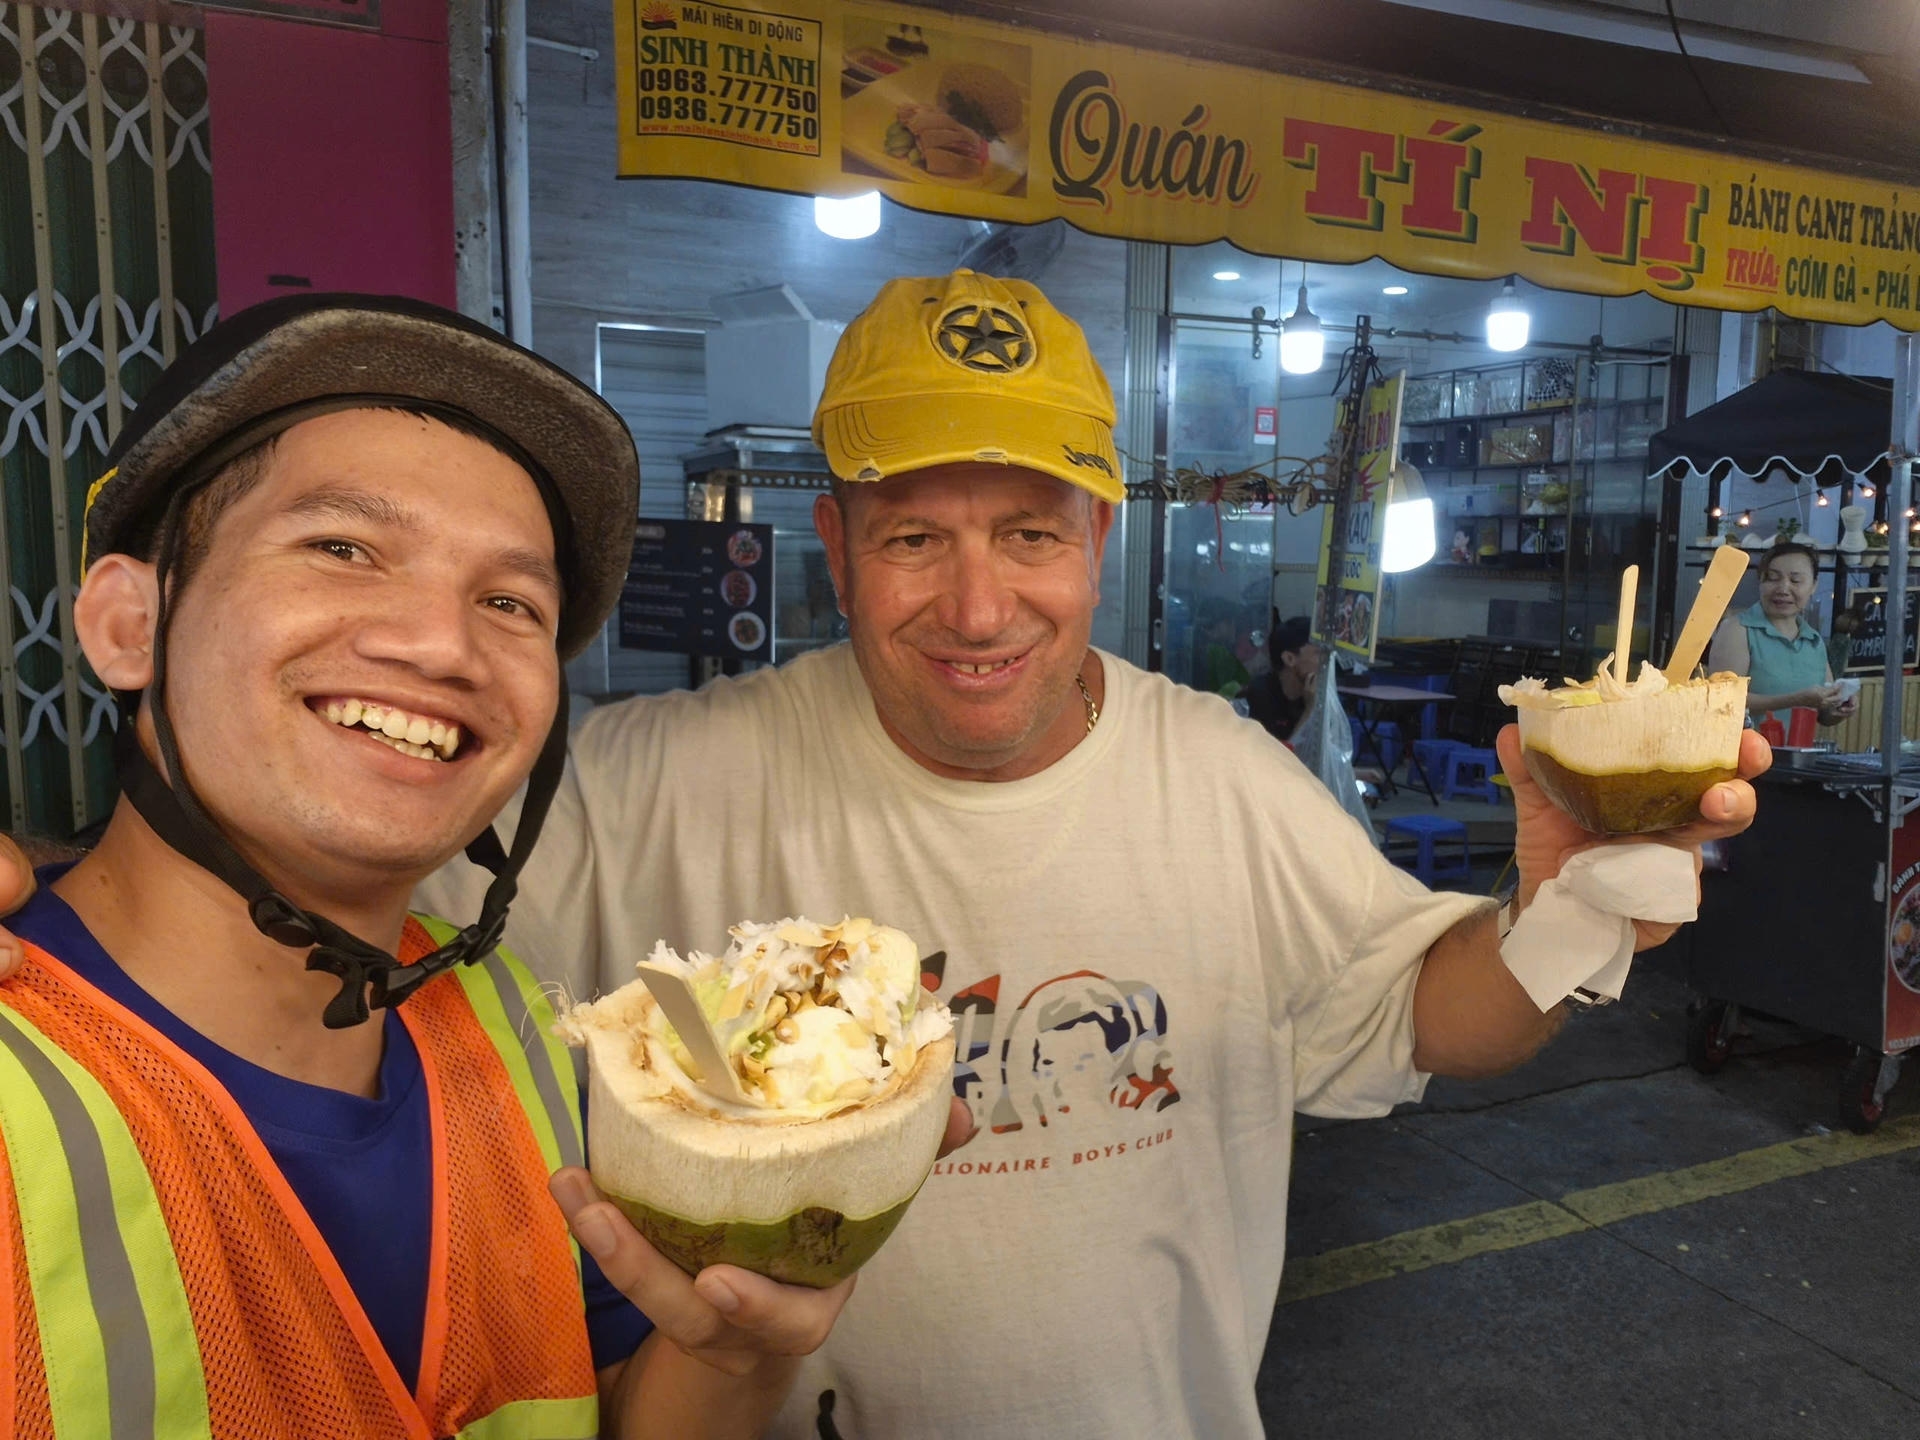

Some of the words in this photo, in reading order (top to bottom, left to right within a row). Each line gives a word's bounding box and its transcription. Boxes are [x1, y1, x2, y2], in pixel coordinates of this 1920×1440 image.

[682, 7, 707, 25] MÁI
[712, 14, 743, 33] HIÊN
[748, 20, 762, 35] DI
[767, 20, 803, 42] ĐỘNG
[640, 35, 708, 68] SINH
[717, 43, 816, 87] THÀNH
[640, 68, 817, 113] 0963.777750
[640, 96, 817, 140] 0936.777750
[1049, 70, 1259, 213] Quán
[1282, 117, 1483, 244] TÍ
[1520, 156, 1709, 290] NỊ
[1728, 173, 1791, 233] BÁNH
[1796, 194, 1855, 243] CANH
[1785, 253, 1828, 299] CƠM
[1834, 255, 1856, 303] GÀ
[1875, 263, 1910, 310] PHÁ
[934, 1157, 1050, 1175] LIONAIRE
[1072, 1142, 1126, 1165] BOYS
[1136, 1128, 1173, 1150] CLUB
